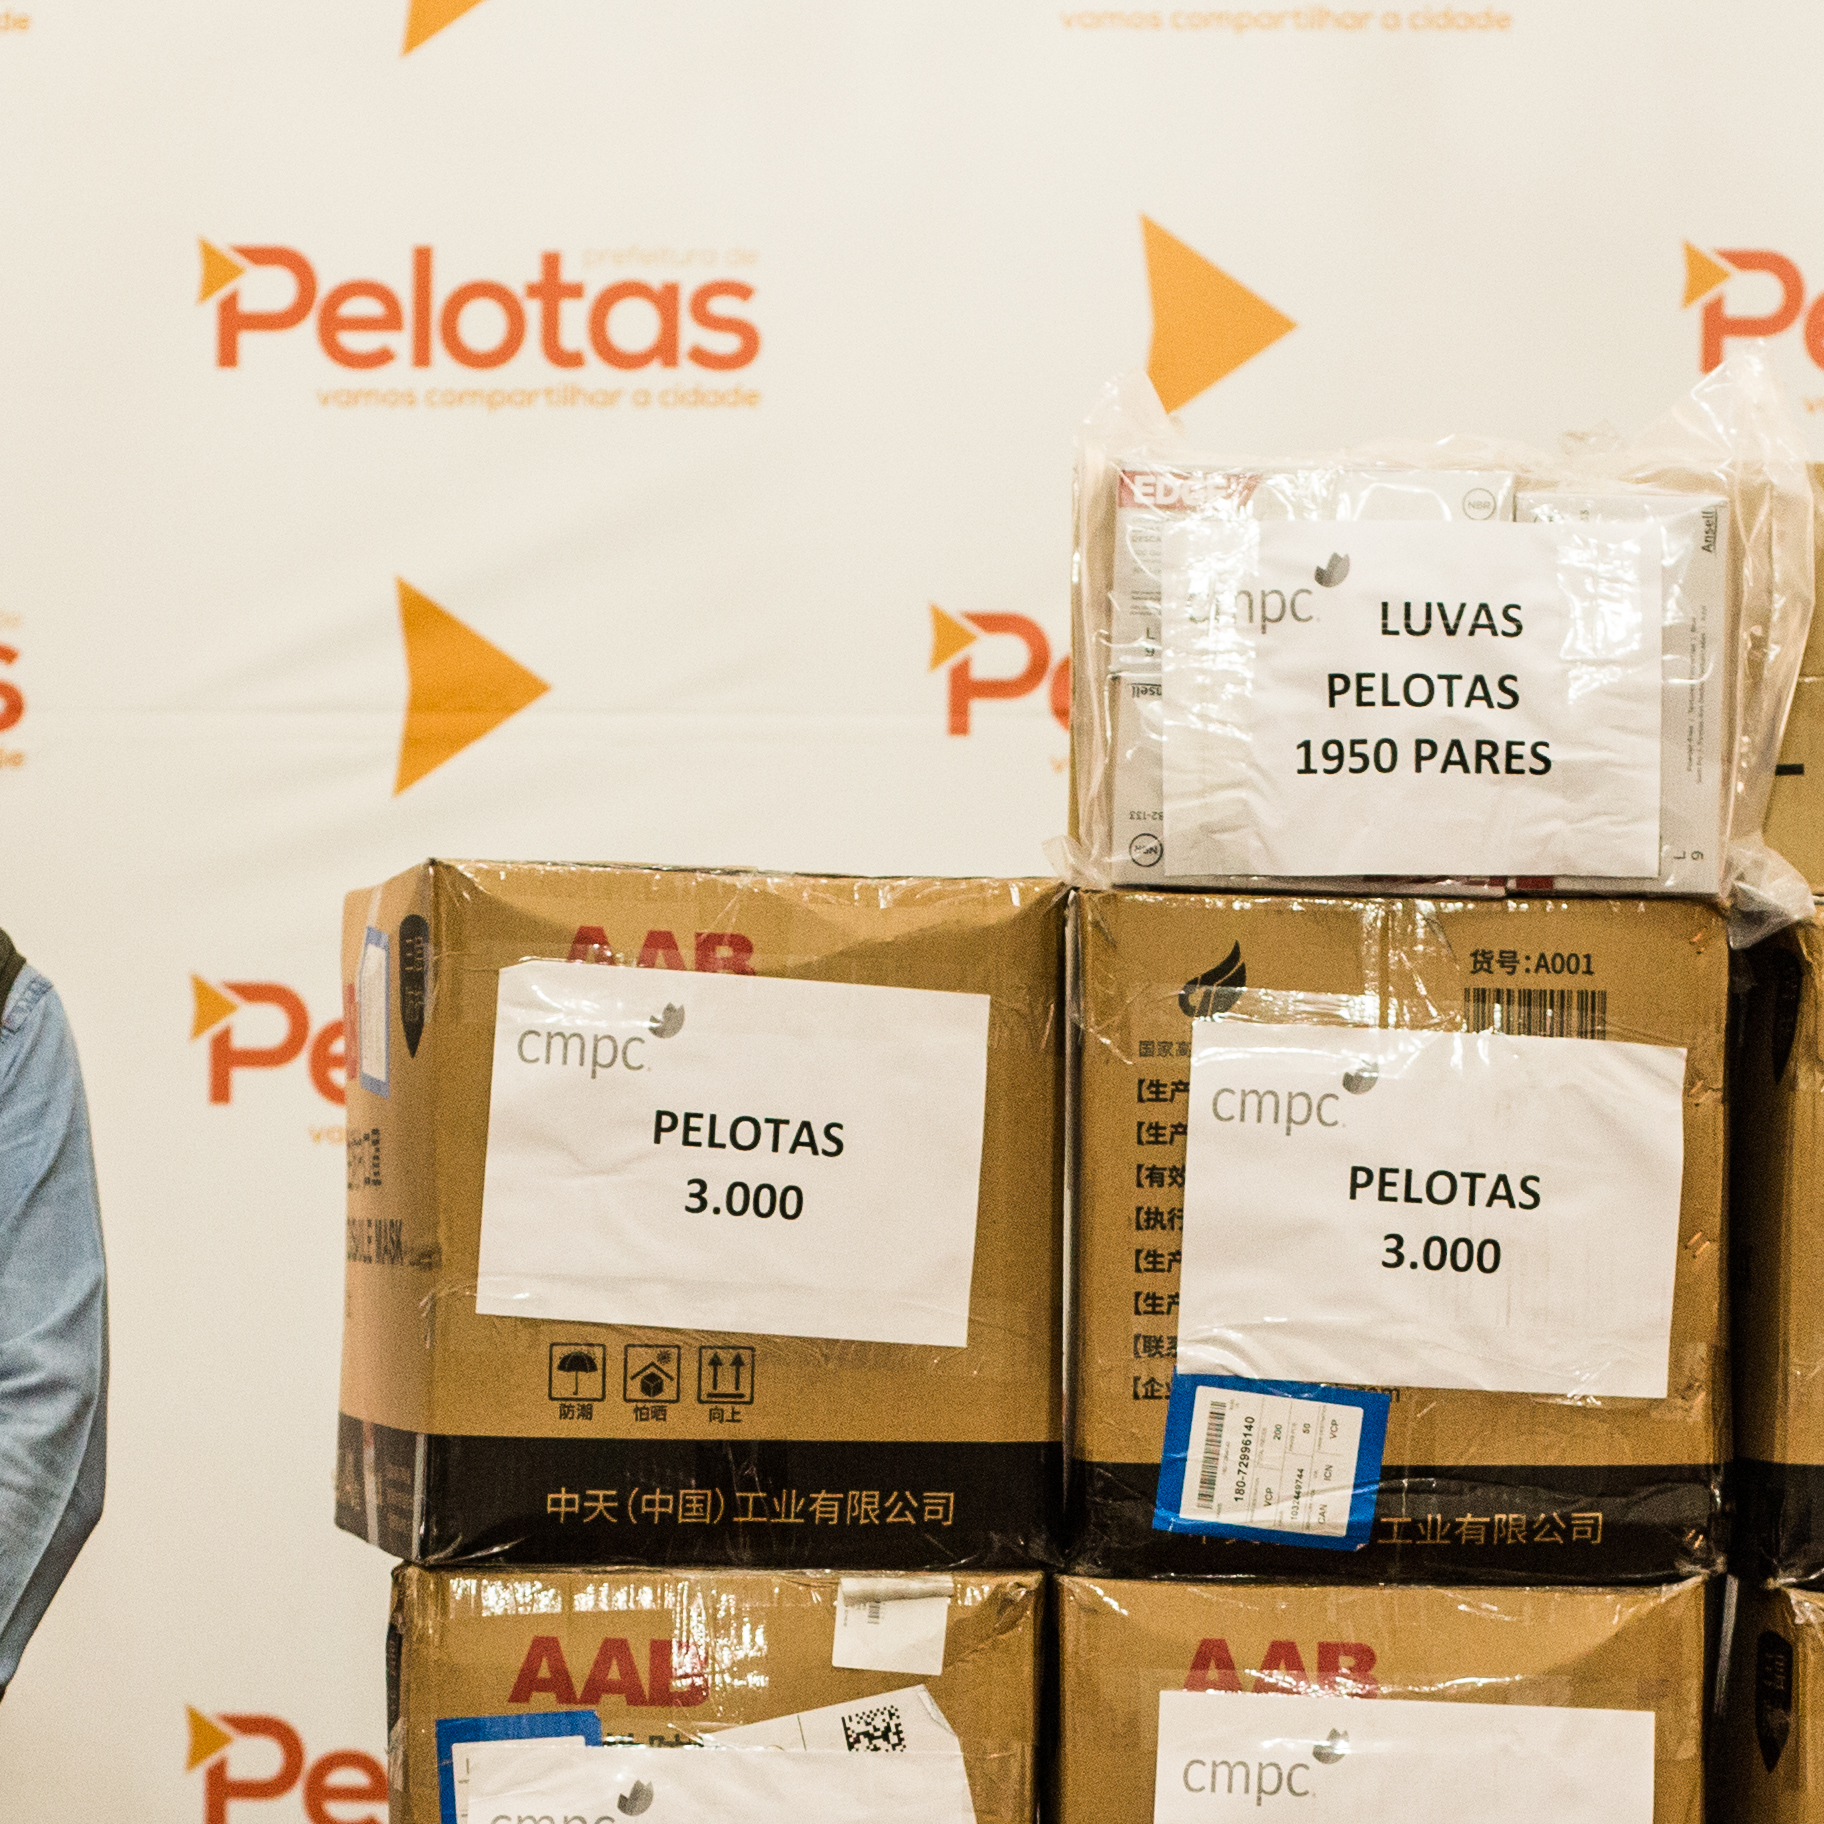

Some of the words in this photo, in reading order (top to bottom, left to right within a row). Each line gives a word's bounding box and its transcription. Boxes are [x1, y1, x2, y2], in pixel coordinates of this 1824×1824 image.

[215, 243, 761, 370] Pelotas
[316, 386, 417, 408] vamos
[424, 382, 622, 412] compartilhar
[632, 387, 651, 408] a
[659, 382, 761, 409] cidade
[1702, 510, 1715, 553] Ansell
[1381, 601, 1523, 638] LUVAS
[1132, 685, 1162, 698] nsell
[1328, 672, 1519, 709] PELOTAS
[1296, 738, 1398, 775] 1950
[1415, 739, 1552, 776] PARES
[565, 925, 756, 976] AAB
[517, 1029, 646, 1078] cmpc
[1212, 1087, 1340, 1135] cmpc
[653, 1110, 844, 1158] PELOTAS
[684, 1178, 803, 1220] 3.000
[1349, 1165, 1541, 1210] PELOTAS
[1381, 1233, 1501, 1274] 3.000
[1132, 1375, 1171, 1400] 【企
[559, 1403, 593, 1420] 防潮
[633, 1404, 668, 1421] 怕晒
[709, 1406, 742, 1423] 向上
[1302, 1422, 1310, 1433] 50
[1329, 1418, 1339, 1439] VCP
[1272, 1423, 1282, 1440] 200
[1233, 1415, 1255, 1502] 180-72996140
[1323, 1464, 1332, 1481] ICN
[1263, 1486, 1273, 1506] VCP
[1316, 1503, 1327, 1524] CAN
[1377, 1512, 1604, 1546] 工业有限公司
[1182, 1637, 1378, 1698] AAB
[1182, 1758, 1310, 1807] cmpc
